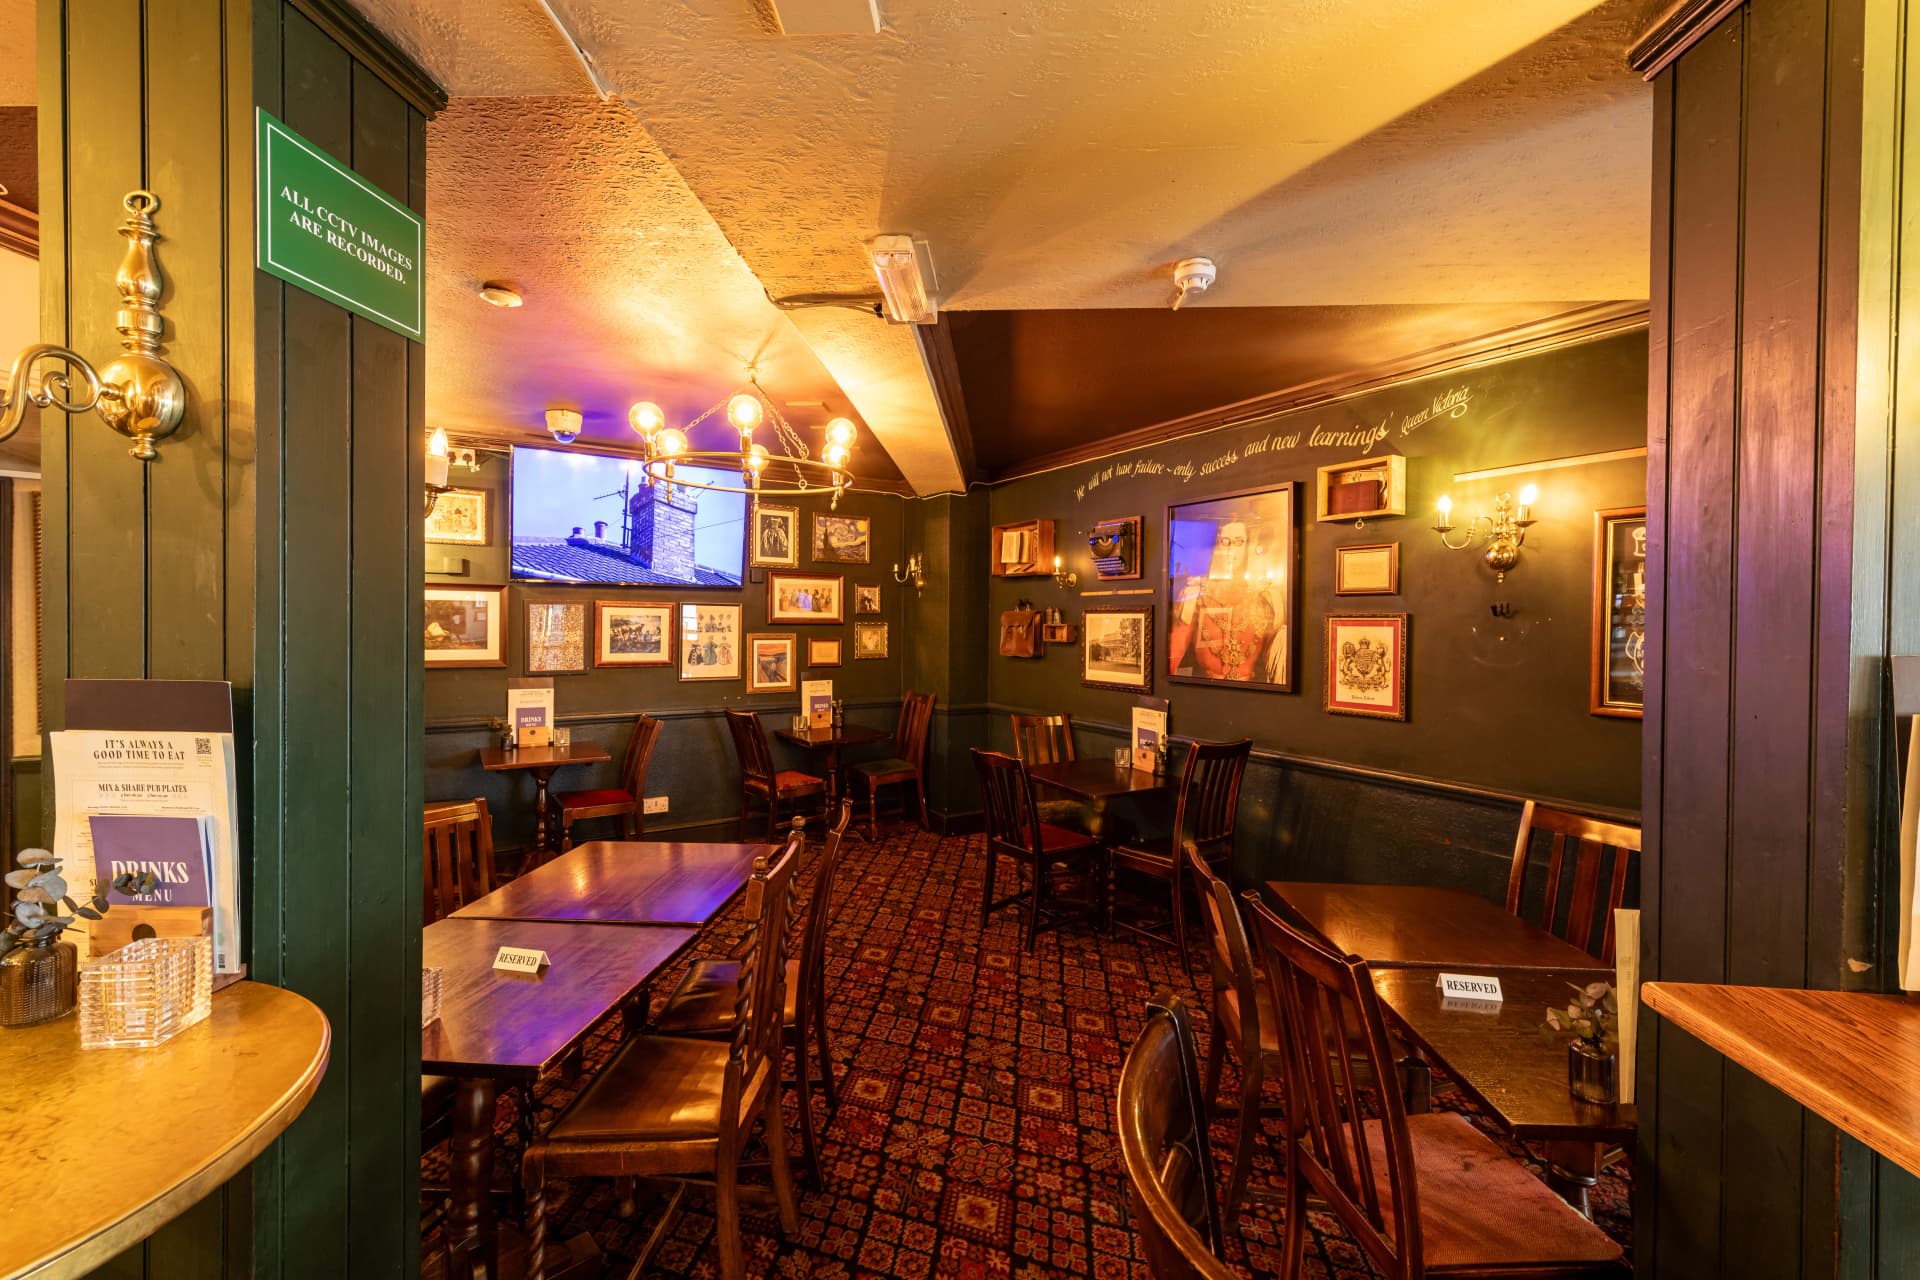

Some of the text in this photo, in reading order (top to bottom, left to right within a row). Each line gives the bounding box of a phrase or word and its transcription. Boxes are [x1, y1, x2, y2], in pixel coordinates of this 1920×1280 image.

[280, 185, 413, 271] ALL CCTV IMAGES
[289, 211, 407, 285] ARE RECORDED.
[1401, 385, 1474, 435] Queen Victoria
[1088, 473, 1100, 491] will
[1101, 466, 1113, 482] not
[1116, 462, 1132, 477] have
[1131, 458, 1165, 478] failure
[1173, 459, 1197, 483] only
[1199, 449, 1238, 477] success
[1244, 433, 1271, 457] and
[1271, 431, 1301, 451] new
[105, 739, 173, 750] IT'S ALWAYS A
[93, 750, 184, 761] GOOD TIME TO EAT
[98, 783, 187, 793] MIX & SHARE PUB PLATES
[111, 860, 190, 884] DRINKS
[498, 952, 538, 967] RESERVED
[1446, 979, 1498, 994] RESERVED
